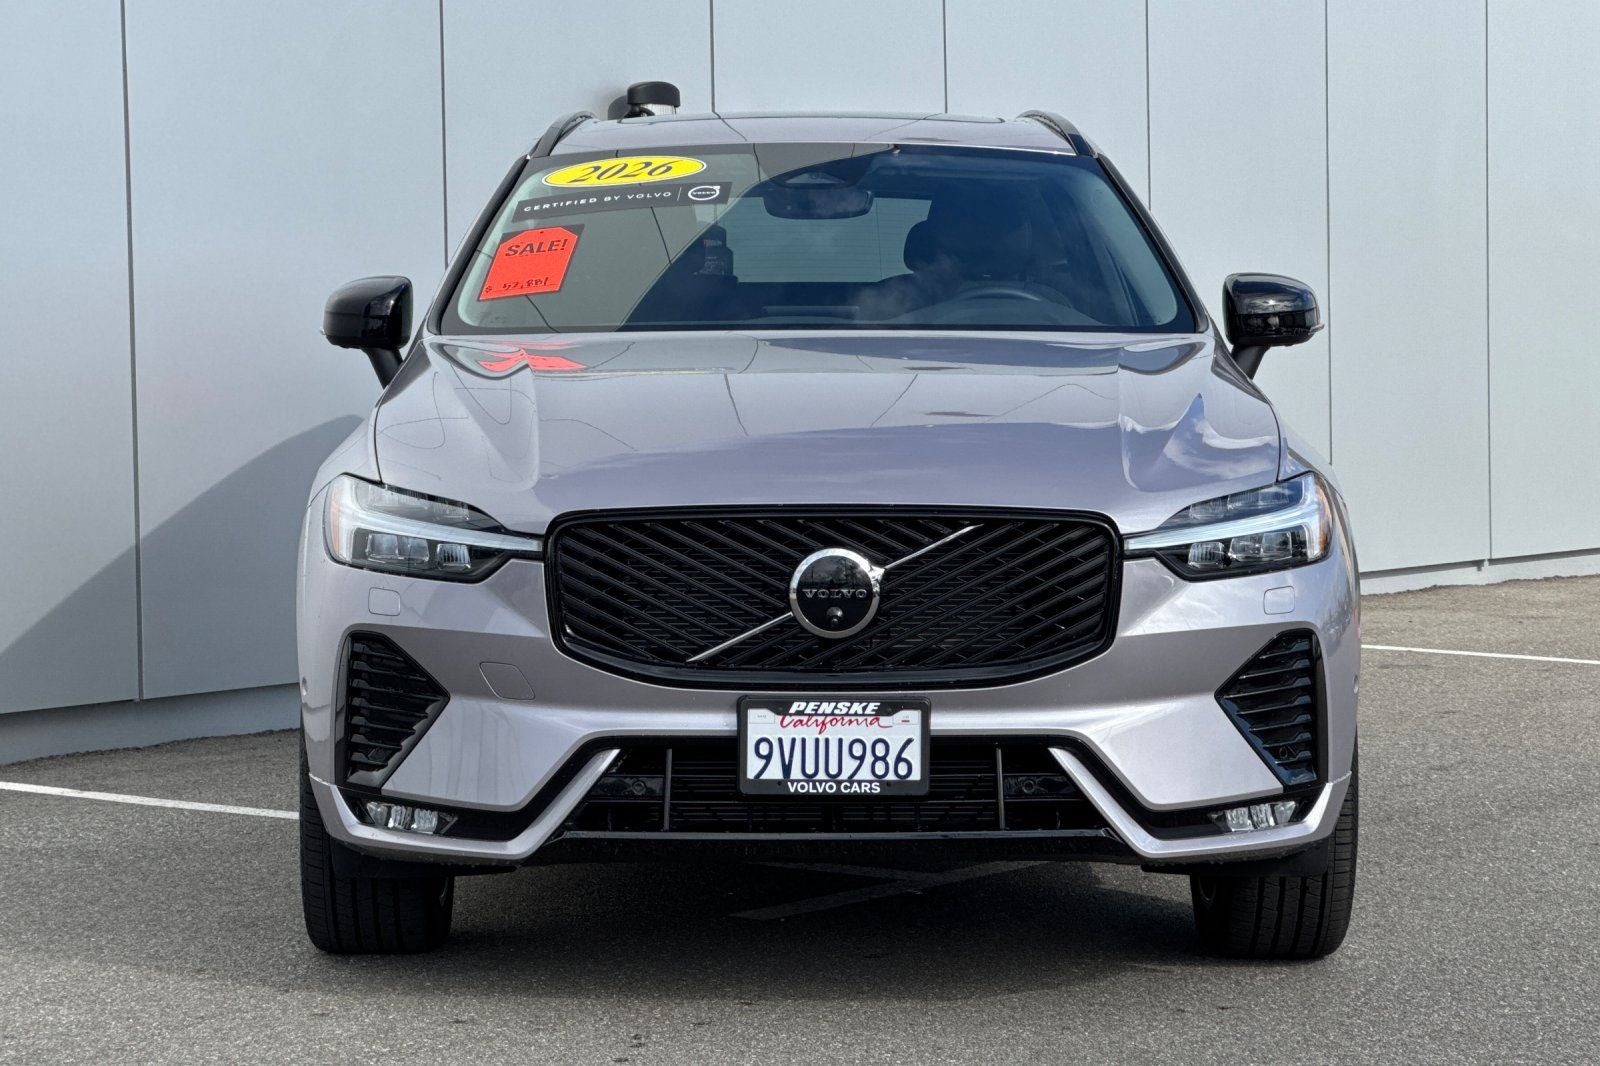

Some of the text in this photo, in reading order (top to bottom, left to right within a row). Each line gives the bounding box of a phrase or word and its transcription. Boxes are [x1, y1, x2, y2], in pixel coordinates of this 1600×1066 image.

[566, 160, 681, 184] 2026
[524, 197, 597, 212] CERTIFIED
[627, 191, 672, 200] VOLVO
[505, 239, 569, 257] SALE!
[802, 588, 867, 599] VOLVO
[788, 701, 881, 715] PENSKE
[779, 714, 893, 735] California
[753, 736, 915, 780] 9VUU986
[788, 781, 881, 793] VOLVO CARS
